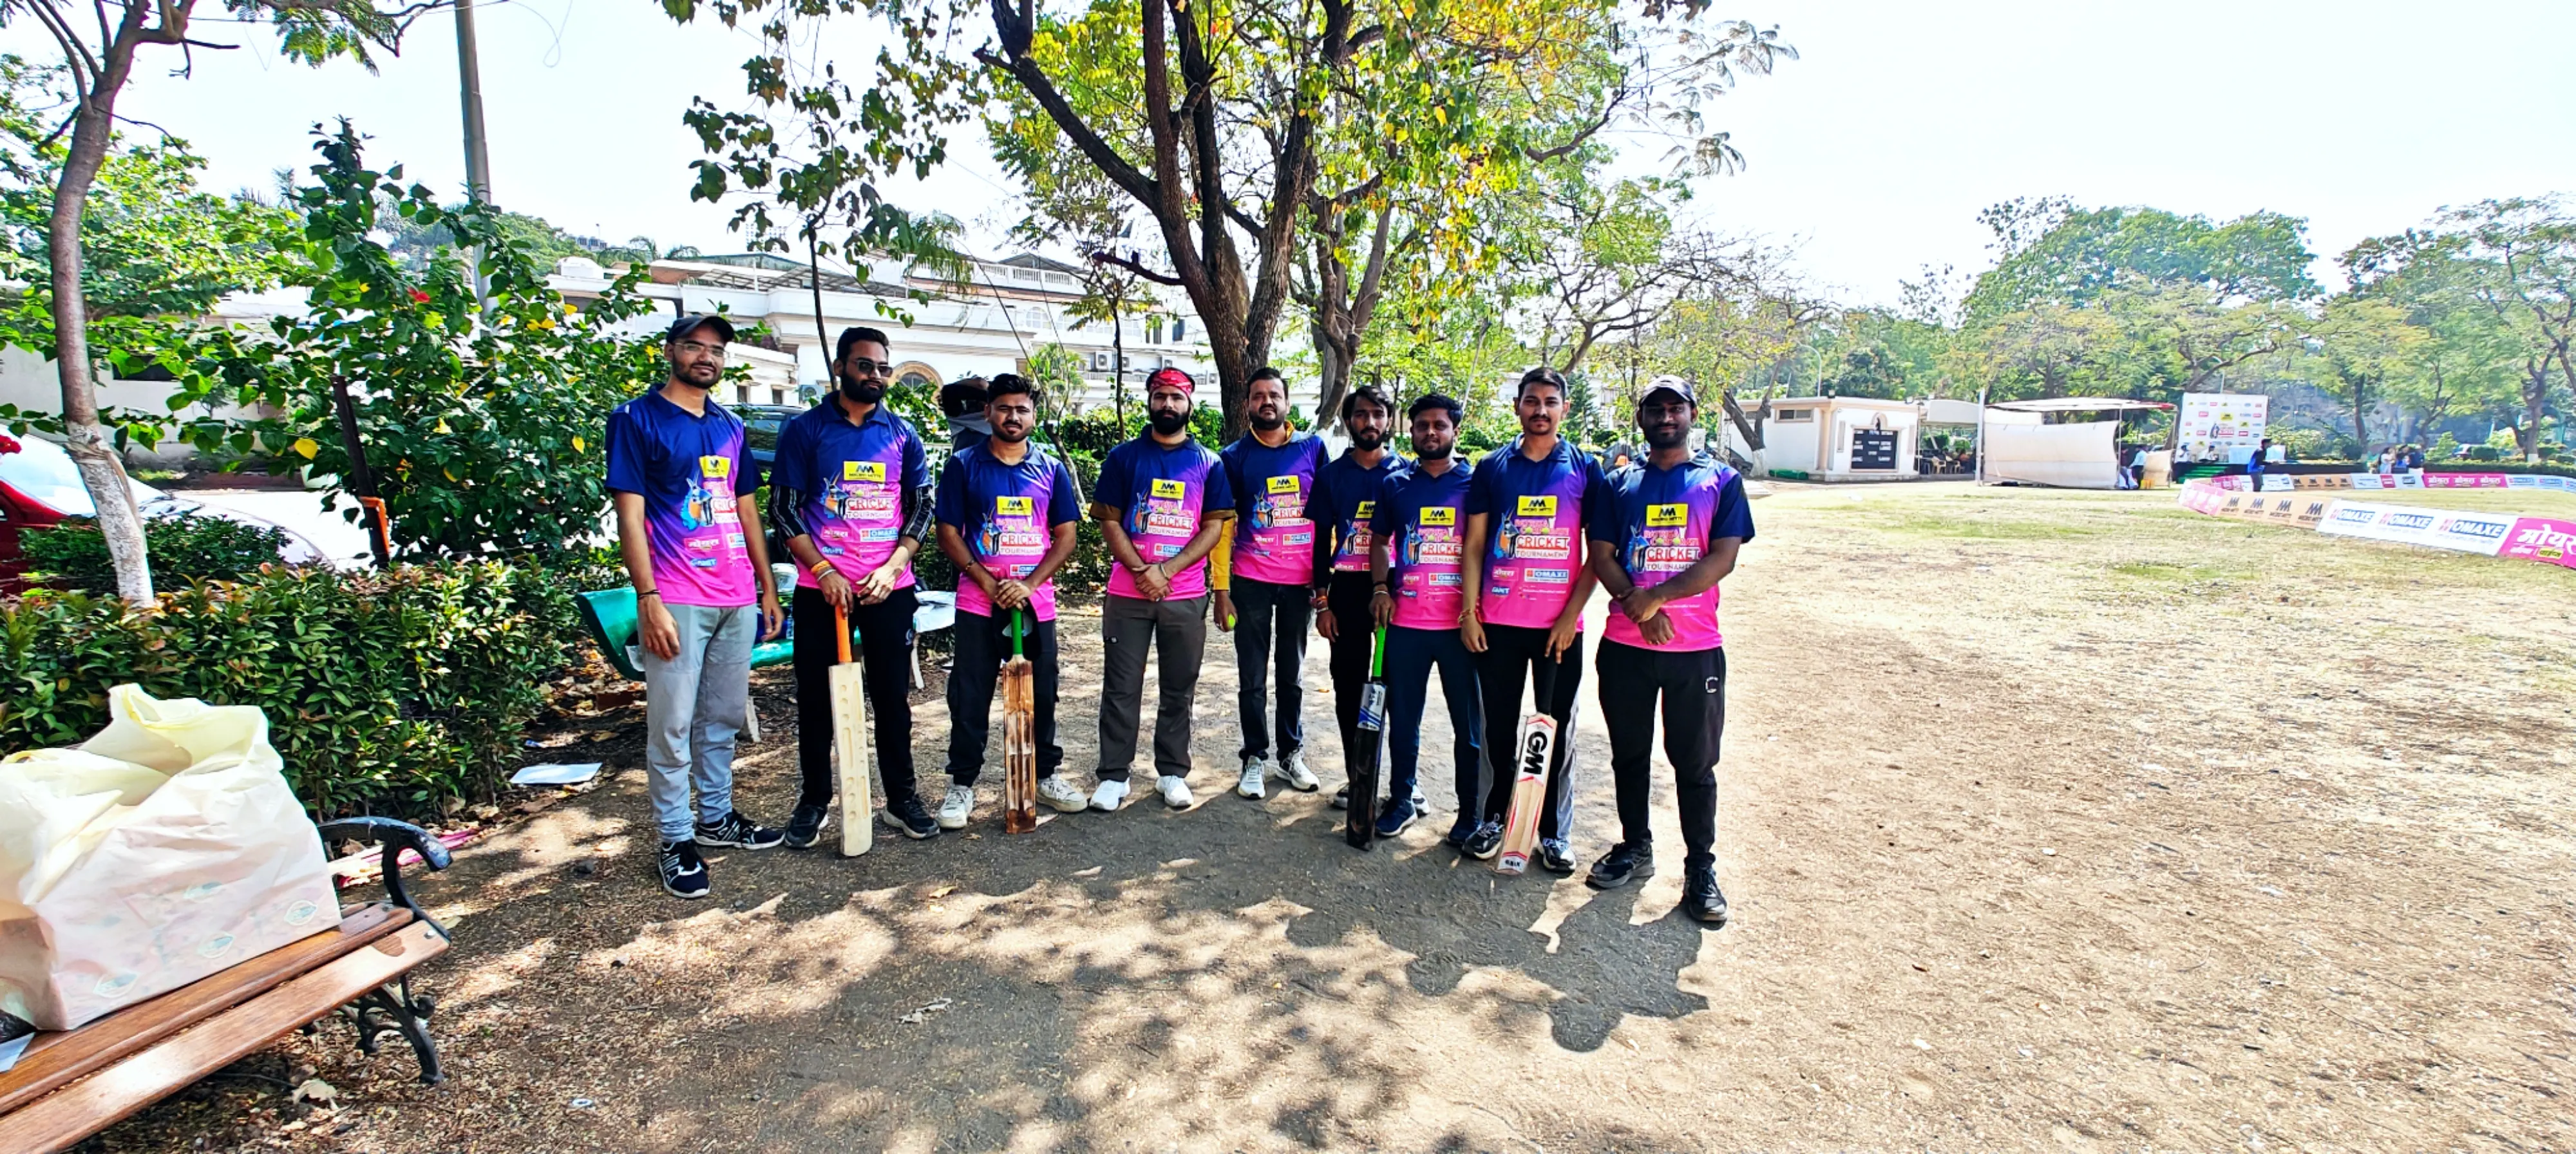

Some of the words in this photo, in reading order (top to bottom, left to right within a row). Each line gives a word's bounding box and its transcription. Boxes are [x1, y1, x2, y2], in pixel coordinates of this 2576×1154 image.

[1149, 515, 1193, 528] CRICKET
[2338, 510, 2374, 522] OMAXE
[2390, 515, 2432, 529] OMAXE
[2451, 520, 2506, 537] OMAXE
[1517, 536, 1569, 549] CRICKET
[1516, 550, 1568, 558] TOURNAMENT
[1647, 548, 1700, 560] CRICKET
[1523, 731, 1548, 775] GM
